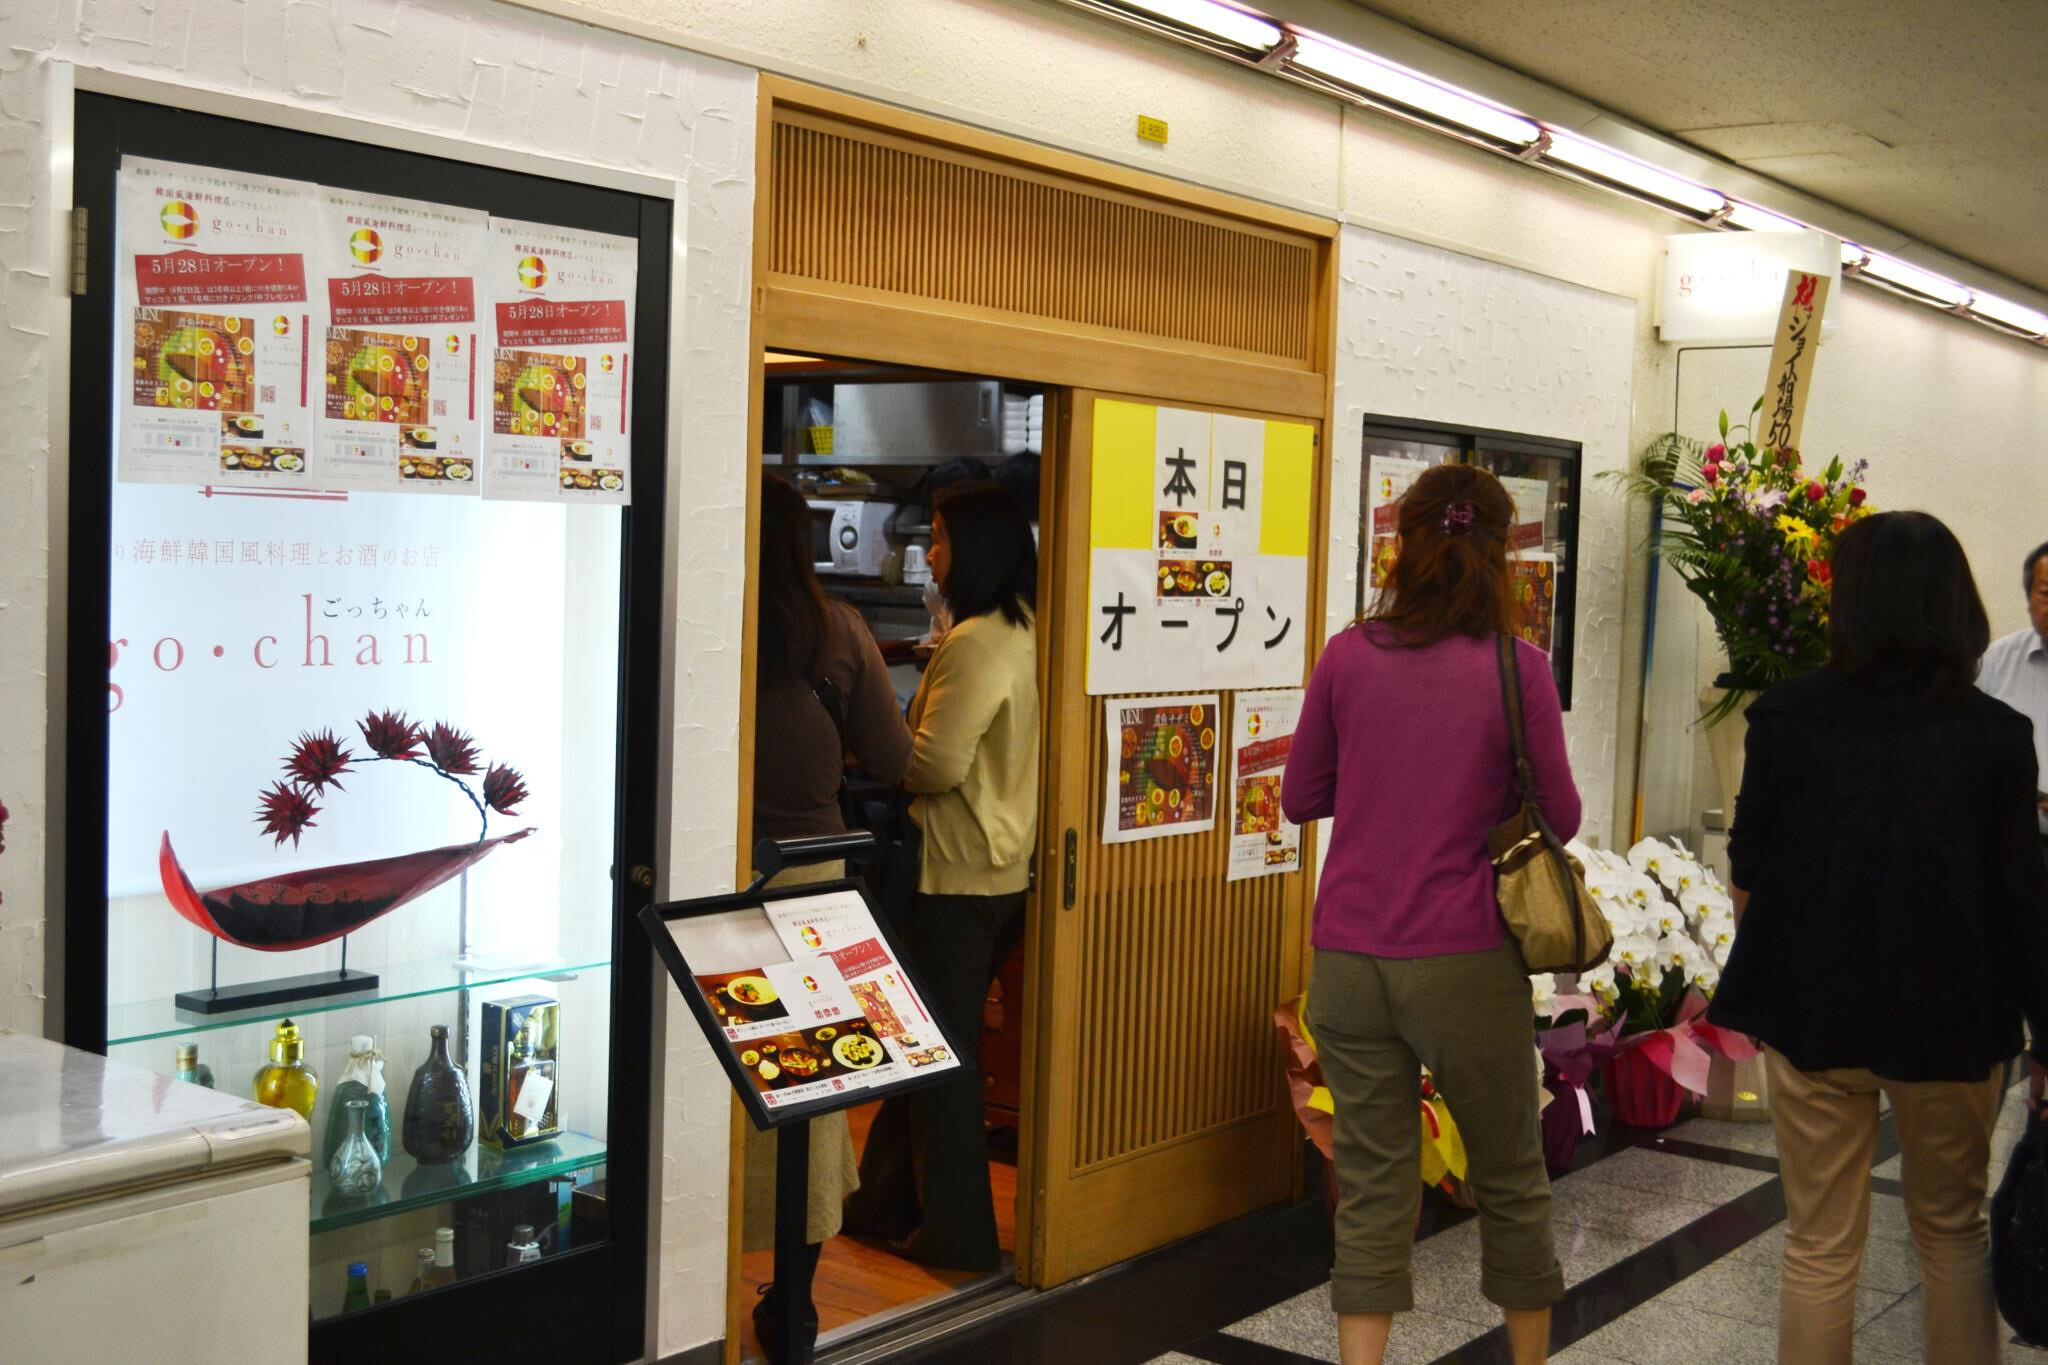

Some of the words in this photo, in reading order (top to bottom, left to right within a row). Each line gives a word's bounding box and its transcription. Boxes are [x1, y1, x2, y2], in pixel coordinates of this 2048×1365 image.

[1163, 447, 1247, 510] 本日
[323, 597, 432, 619] ごっちゃん
[1100, 591, 1292, 653] オープン
